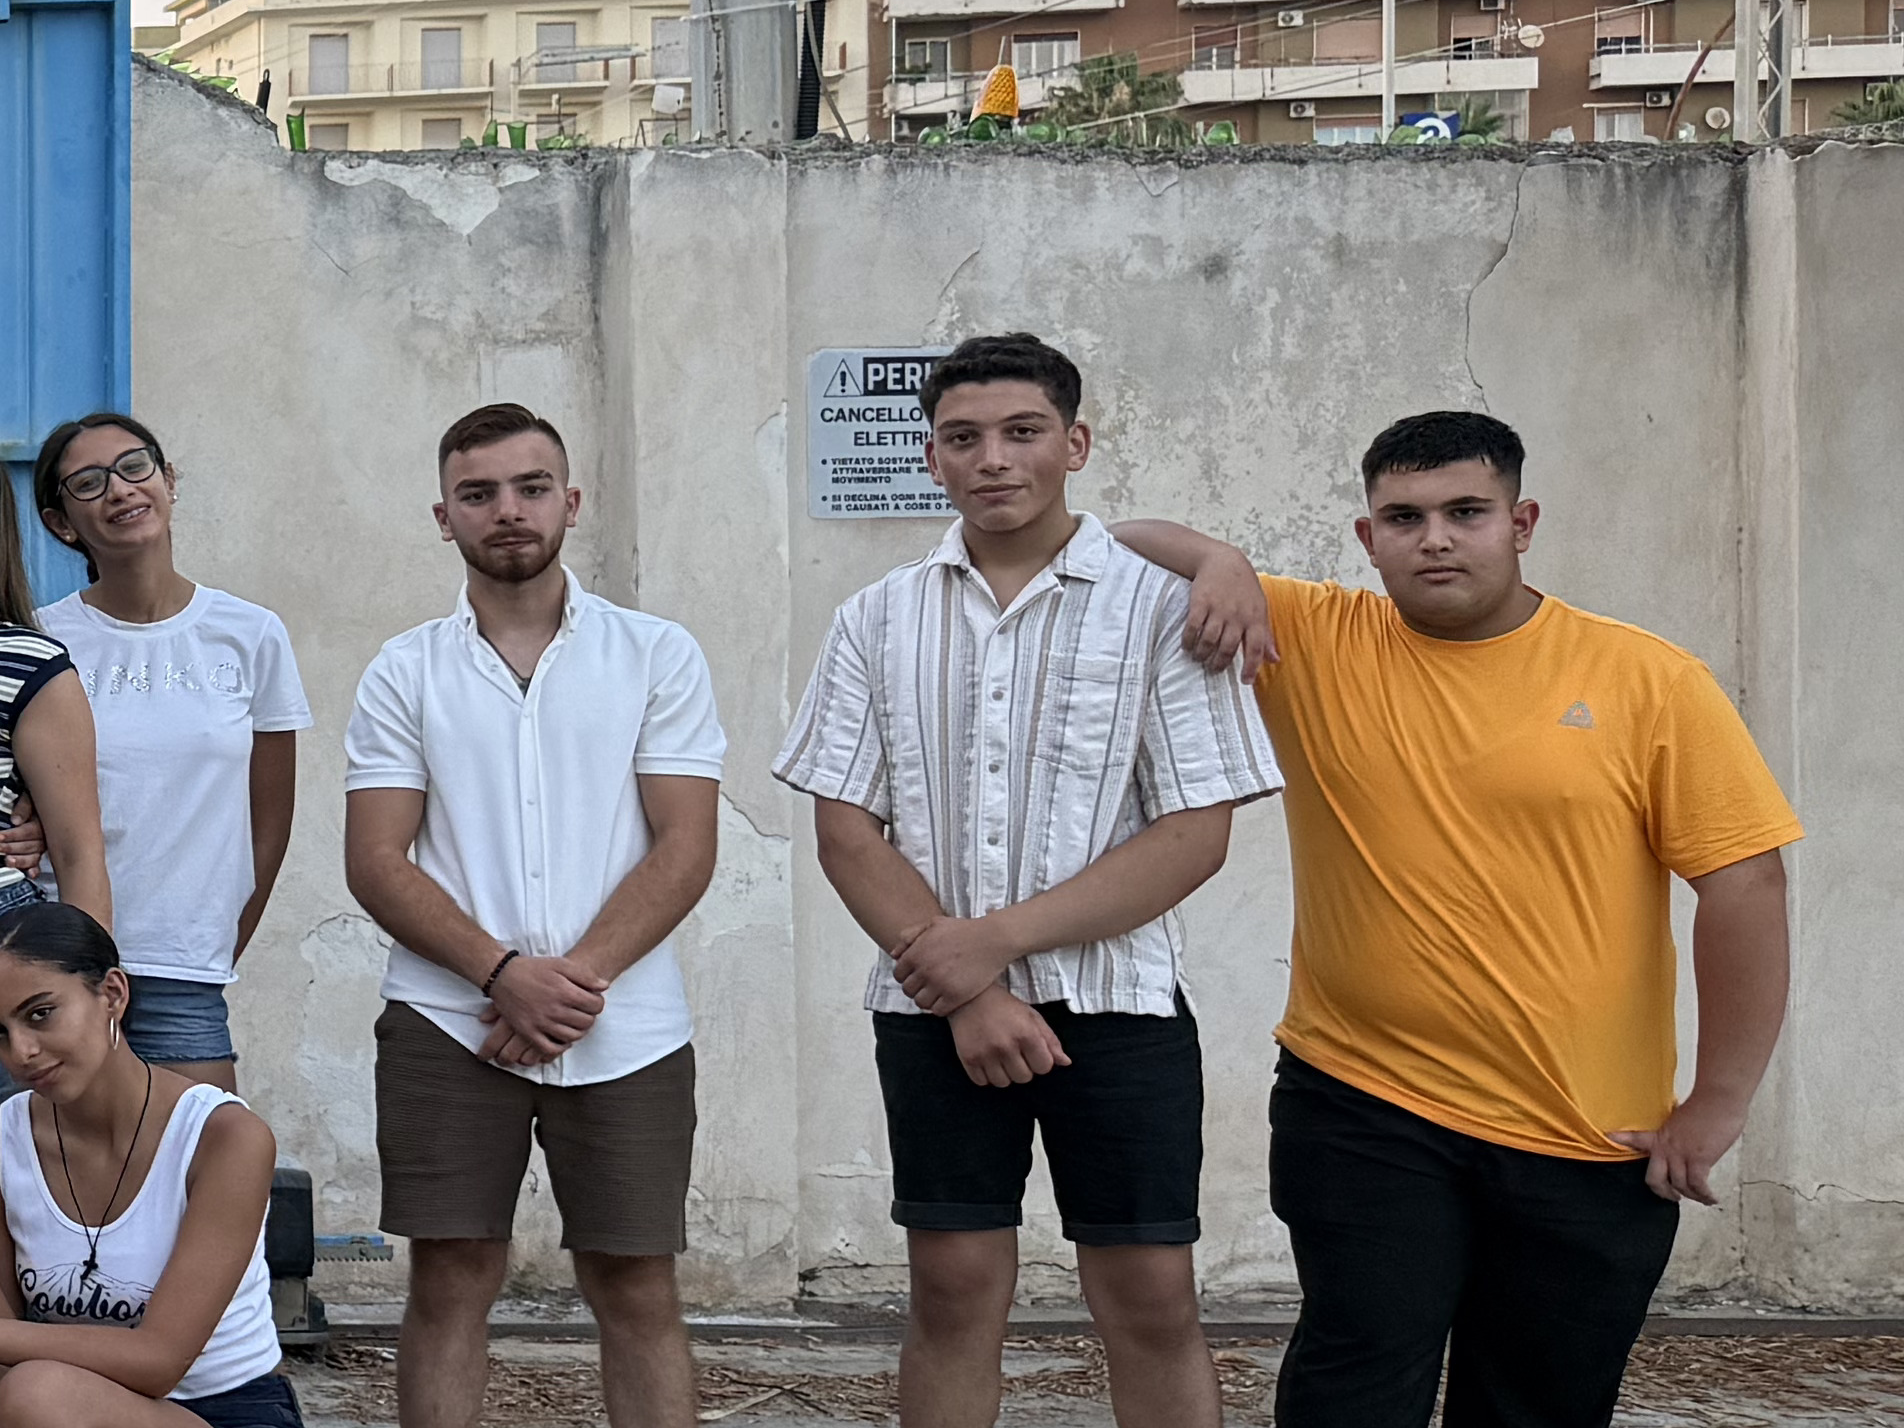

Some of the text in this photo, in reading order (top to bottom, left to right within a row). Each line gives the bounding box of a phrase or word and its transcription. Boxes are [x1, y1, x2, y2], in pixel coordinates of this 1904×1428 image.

[867, 362, 932, 391] PERI
[820, 407, 924, 423] CANCELLO
[853, 430, 933, 447] ELETTRI
[831, 456, 924, 466] VIETATO SOSTARE
[832, 466, 912, 475] ATTRAVERSARE
[832, 476, 892, 484] MOVIMENTO
[844, 493, 887, 502] DECLINA
[845, 503, 890, 512] CAUSATI
[894, 503, 901, 511] A
[905, 502, 931, 511] COSE
[86, 661, 242, 697] INKO
